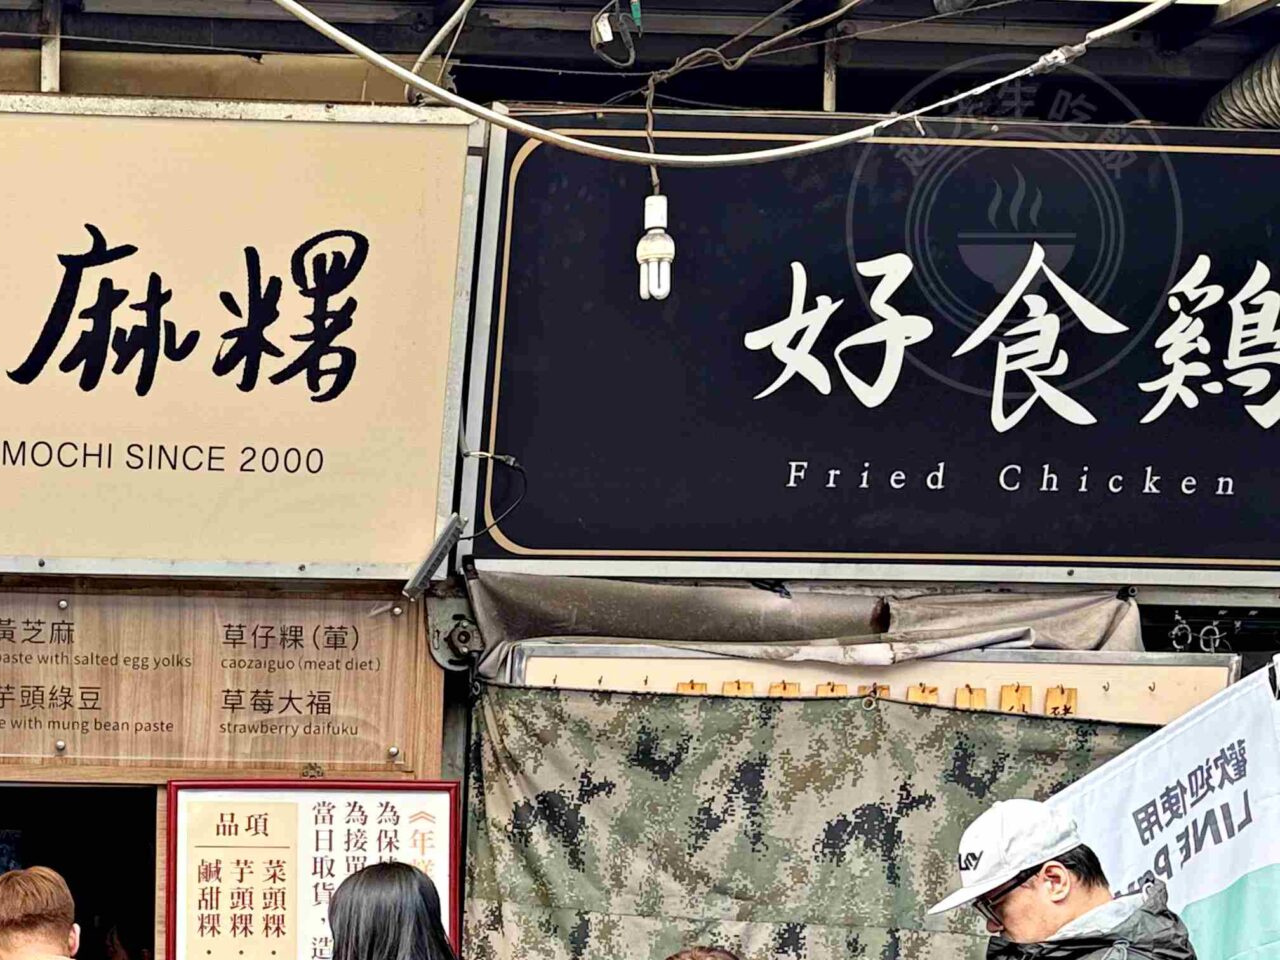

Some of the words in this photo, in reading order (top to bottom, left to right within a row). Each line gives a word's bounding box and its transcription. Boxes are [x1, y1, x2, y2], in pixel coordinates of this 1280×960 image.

[3, 439, 113, 469] MOCHI
[126, 443, 225, 472] SINCE
[239, 446, 325, 474] 2000
[786, 461, 946, 490] Fried
[998, 464, 1235, 495] Chicken
[36, 652, 70, 665] with
[73, 653, 119, 666] salted
[123, 656, 150, 669] egg
[152, 654, 192, 669] yolks
[221, 689, 332, 715] 草莓大福
[11, 717, 43, 731] with
[48, 719, 90, 734] mung
[94, 718, 129, 732] bean
[134, 720, 174, 735] paste
[220, 721, 299, 738] strawberry
[304, 721, 359, 736] daifuku
[215, 812, 270, 838] 品項
